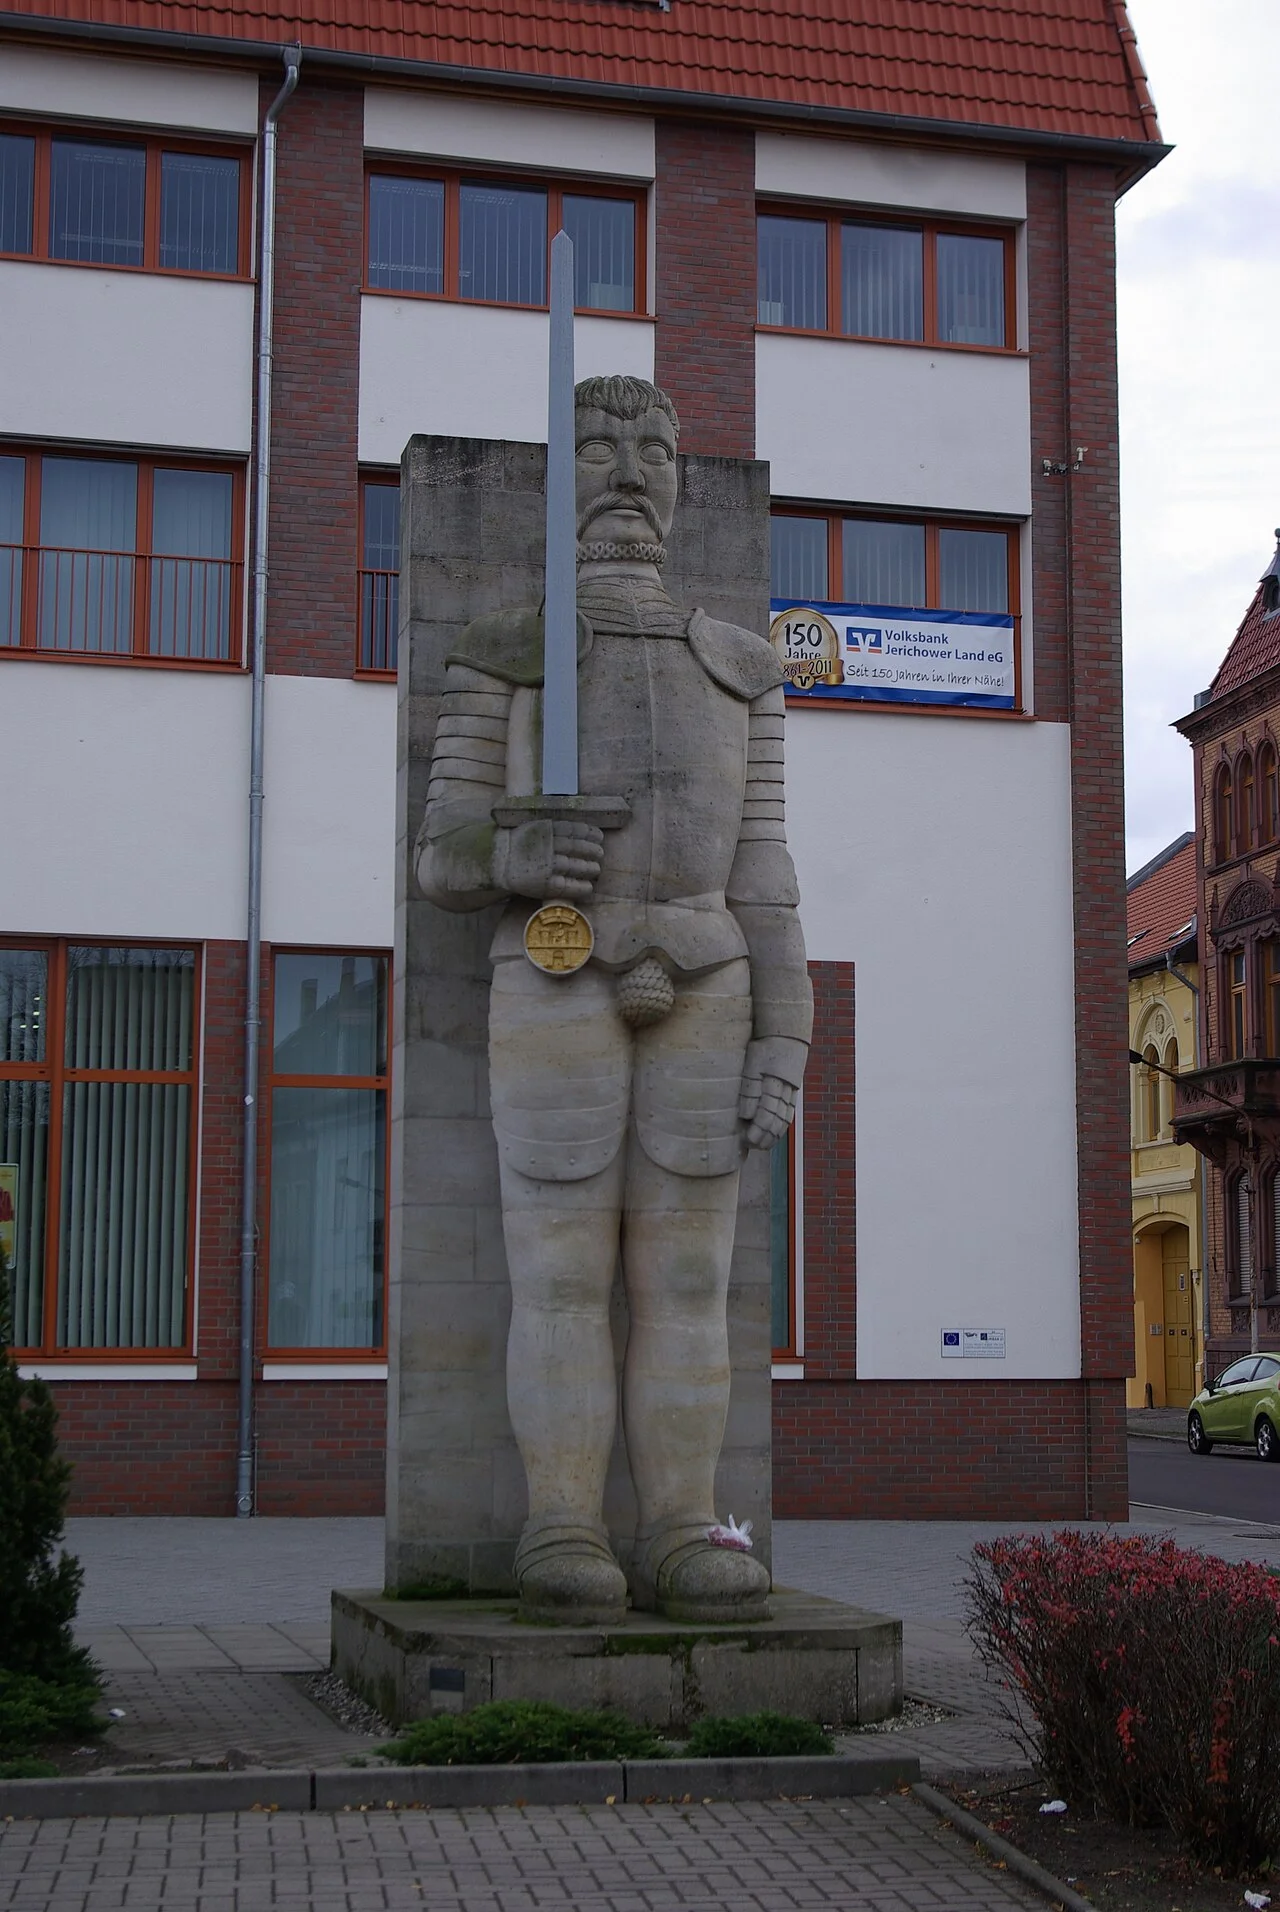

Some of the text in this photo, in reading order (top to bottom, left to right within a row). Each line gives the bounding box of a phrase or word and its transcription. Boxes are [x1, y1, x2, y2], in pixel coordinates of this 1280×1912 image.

[784, 622, 823, 647] 150
[884, 629, 949, 645] Volksbank
[784, 647, 821, 660] Jahre
[884, 644, 1003, 663] Jerichower Land eG
[782, 659, 832, 677] 861-2011
[846, 663, 1004, 687] Seit 150 Jahren in Ihrer Nähe!
